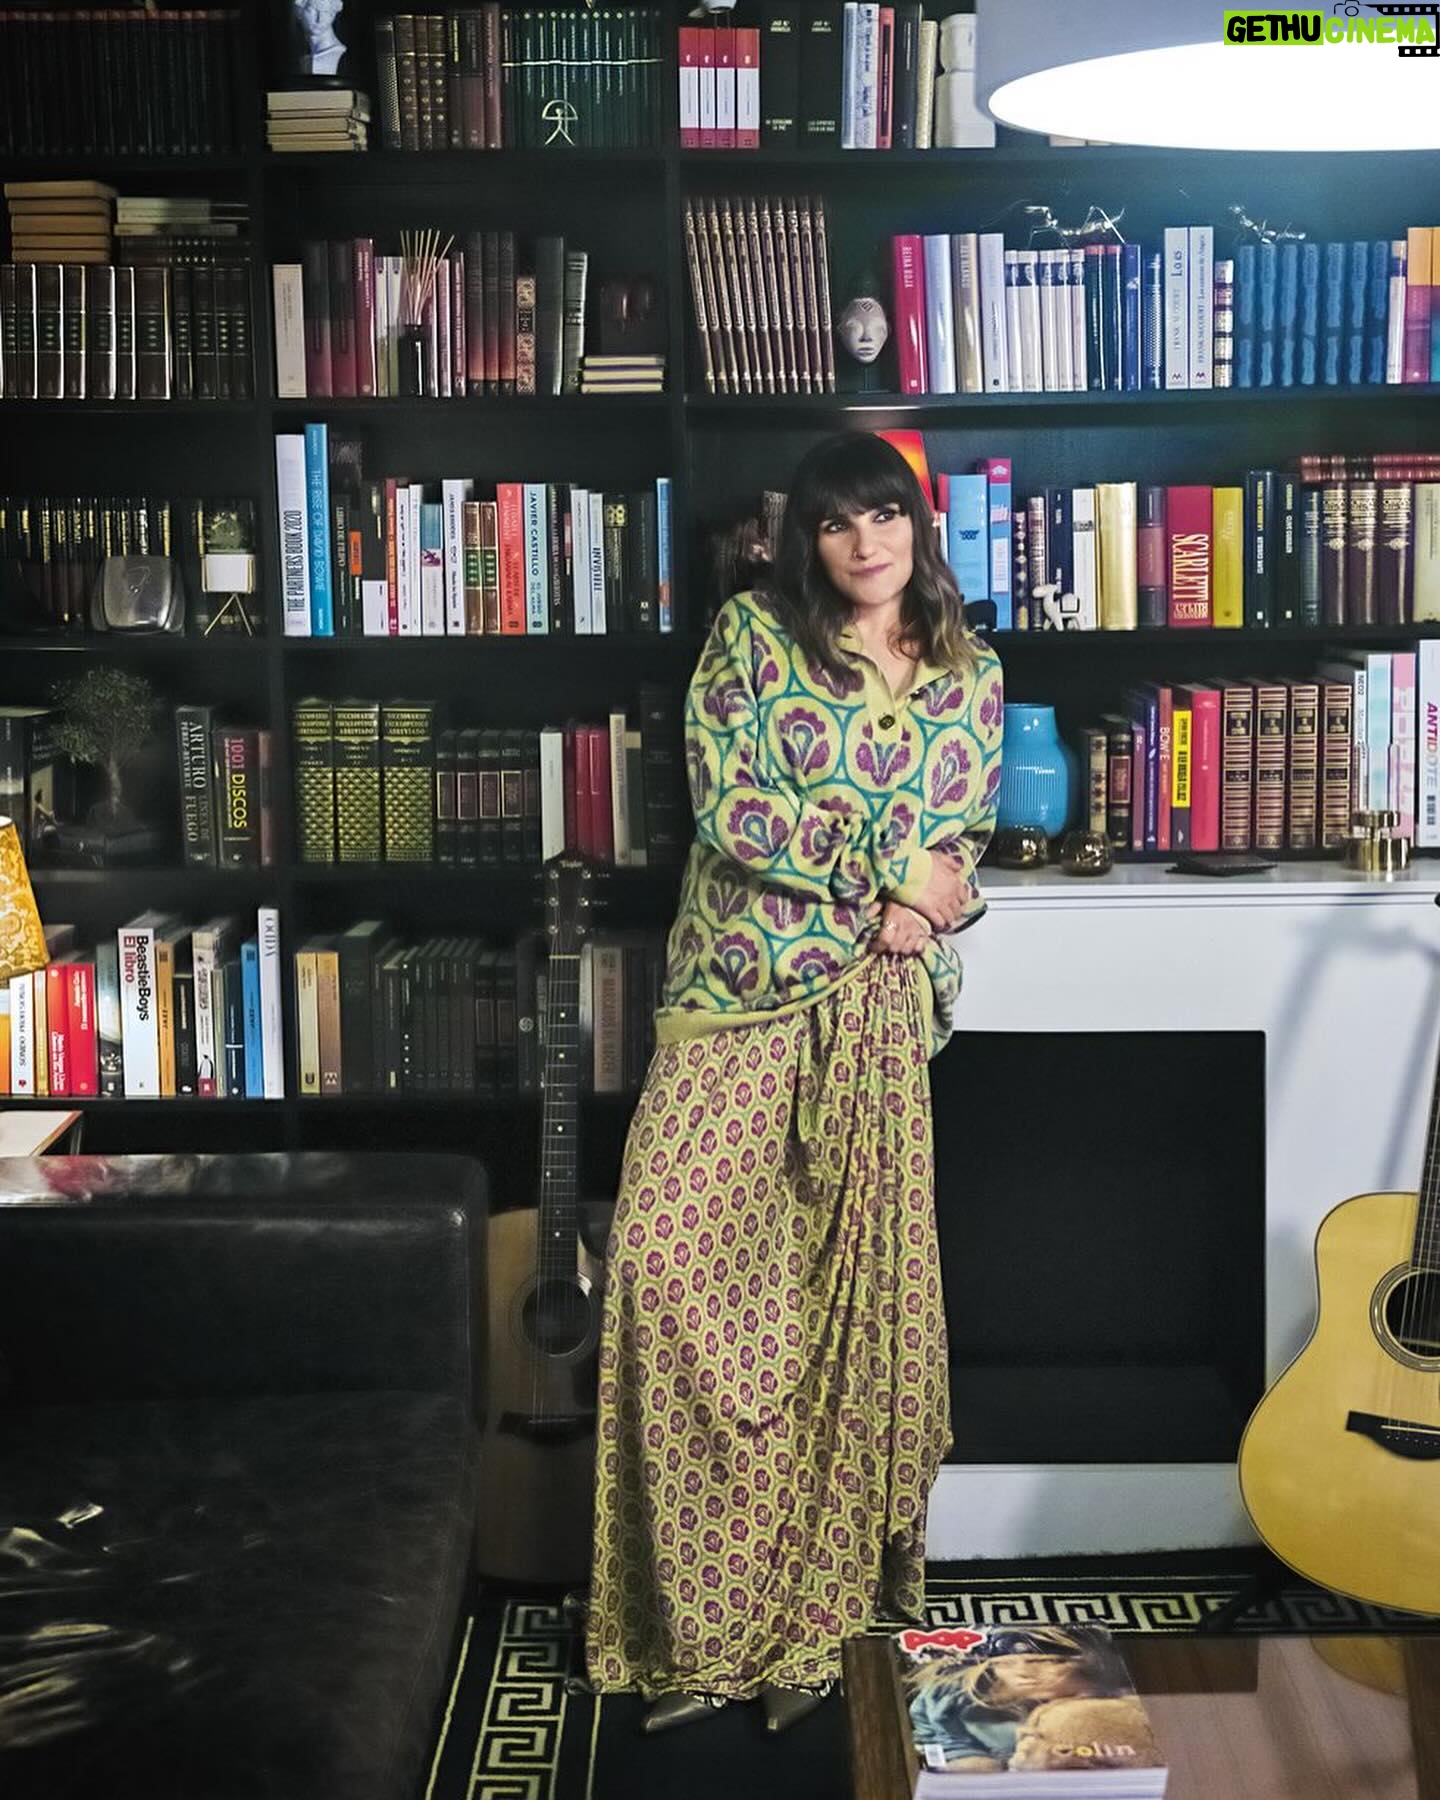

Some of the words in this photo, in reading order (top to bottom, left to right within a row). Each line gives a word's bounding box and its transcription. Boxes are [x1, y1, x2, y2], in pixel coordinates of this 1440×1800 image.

[311, 467, 323, 486] THE
[312, 489, 323, 509] RISE
[529, 491, 538, 526] JAVIER
[283, 510, 303, 532] 2020
[312, 512, 324, 527] OF
[284, 532, 303, 554] BOOK
[313, 530, 325, 557] DAVID
[530, 528, 540, 576] CASTILLO
[285, 554, 305, 596] PARTNERS
[313, 560, 326, 591] BOWIE
[1172, 533, 1209, 601] SCARLETT
[287, 597, 305, 613] THE
[189, 721, 207, 789] ARTURO
[230, 737, 245, 769] 1001
[1426, 701, 1438, 789] ANTIDOTE
[231, 773, 247, 829] DISCOS
[185, 794, 199, 843] FUEGO
[123, 935, 135, 948] El
[124, 951, 138, 984] libro
[901, 1628, 985, 1652] POP
[1052, 1740, 1137, 1758] Colin
